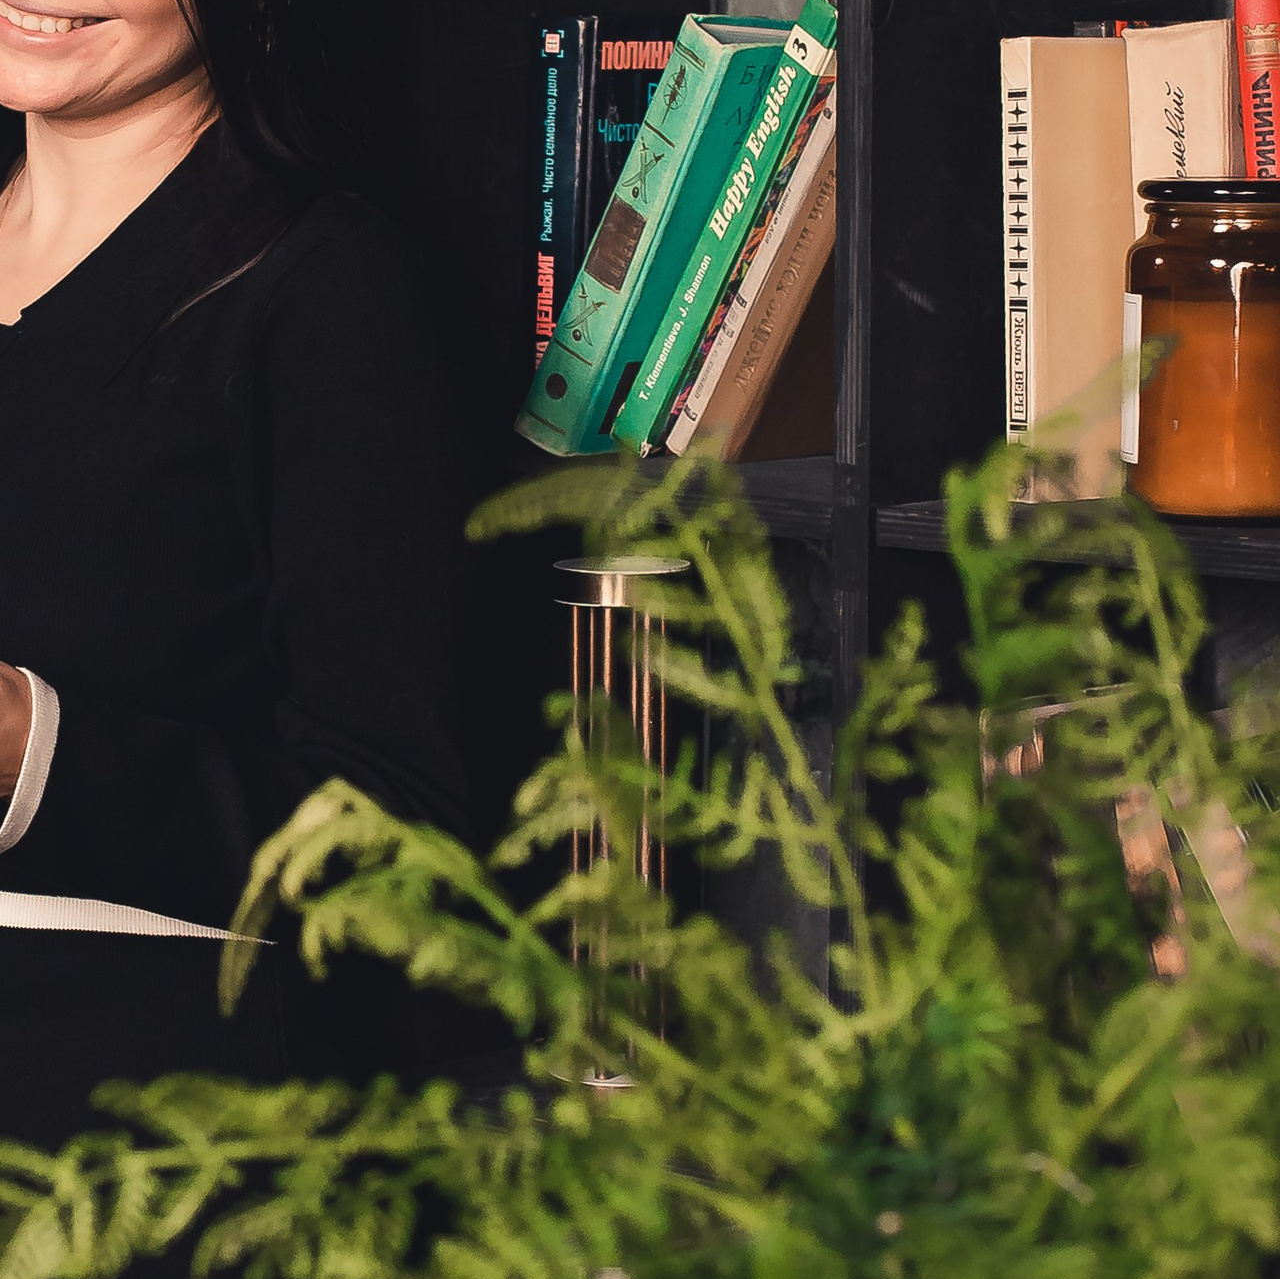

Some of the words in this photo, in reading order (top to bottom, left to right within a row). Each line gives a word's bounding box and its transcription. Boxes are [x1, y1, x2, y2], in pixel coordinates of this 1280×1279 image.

[547, 67, 558, 97] дело
[544, 97, 557, 156] семейное
[708, 157, 756, 241] Happy
[745, 64, 797, 160] English
[792, 37, 809, 61] 3
[1164, 81, 1188, 179] емский
[1251, 70, 1277, 179] РИНИНА
[542, 157, 555, 193] Чисто
[536, 251, 557, 337] ДЕЛЬВИГ
[638, 389, 650, 401] T.
[678, 306, 689, 319] J.
[684, 254, 712, 305] Shannon
[1014, 317, 1024, 367] Жюль
[1014, 370, 1024, 414] ВЕРН
